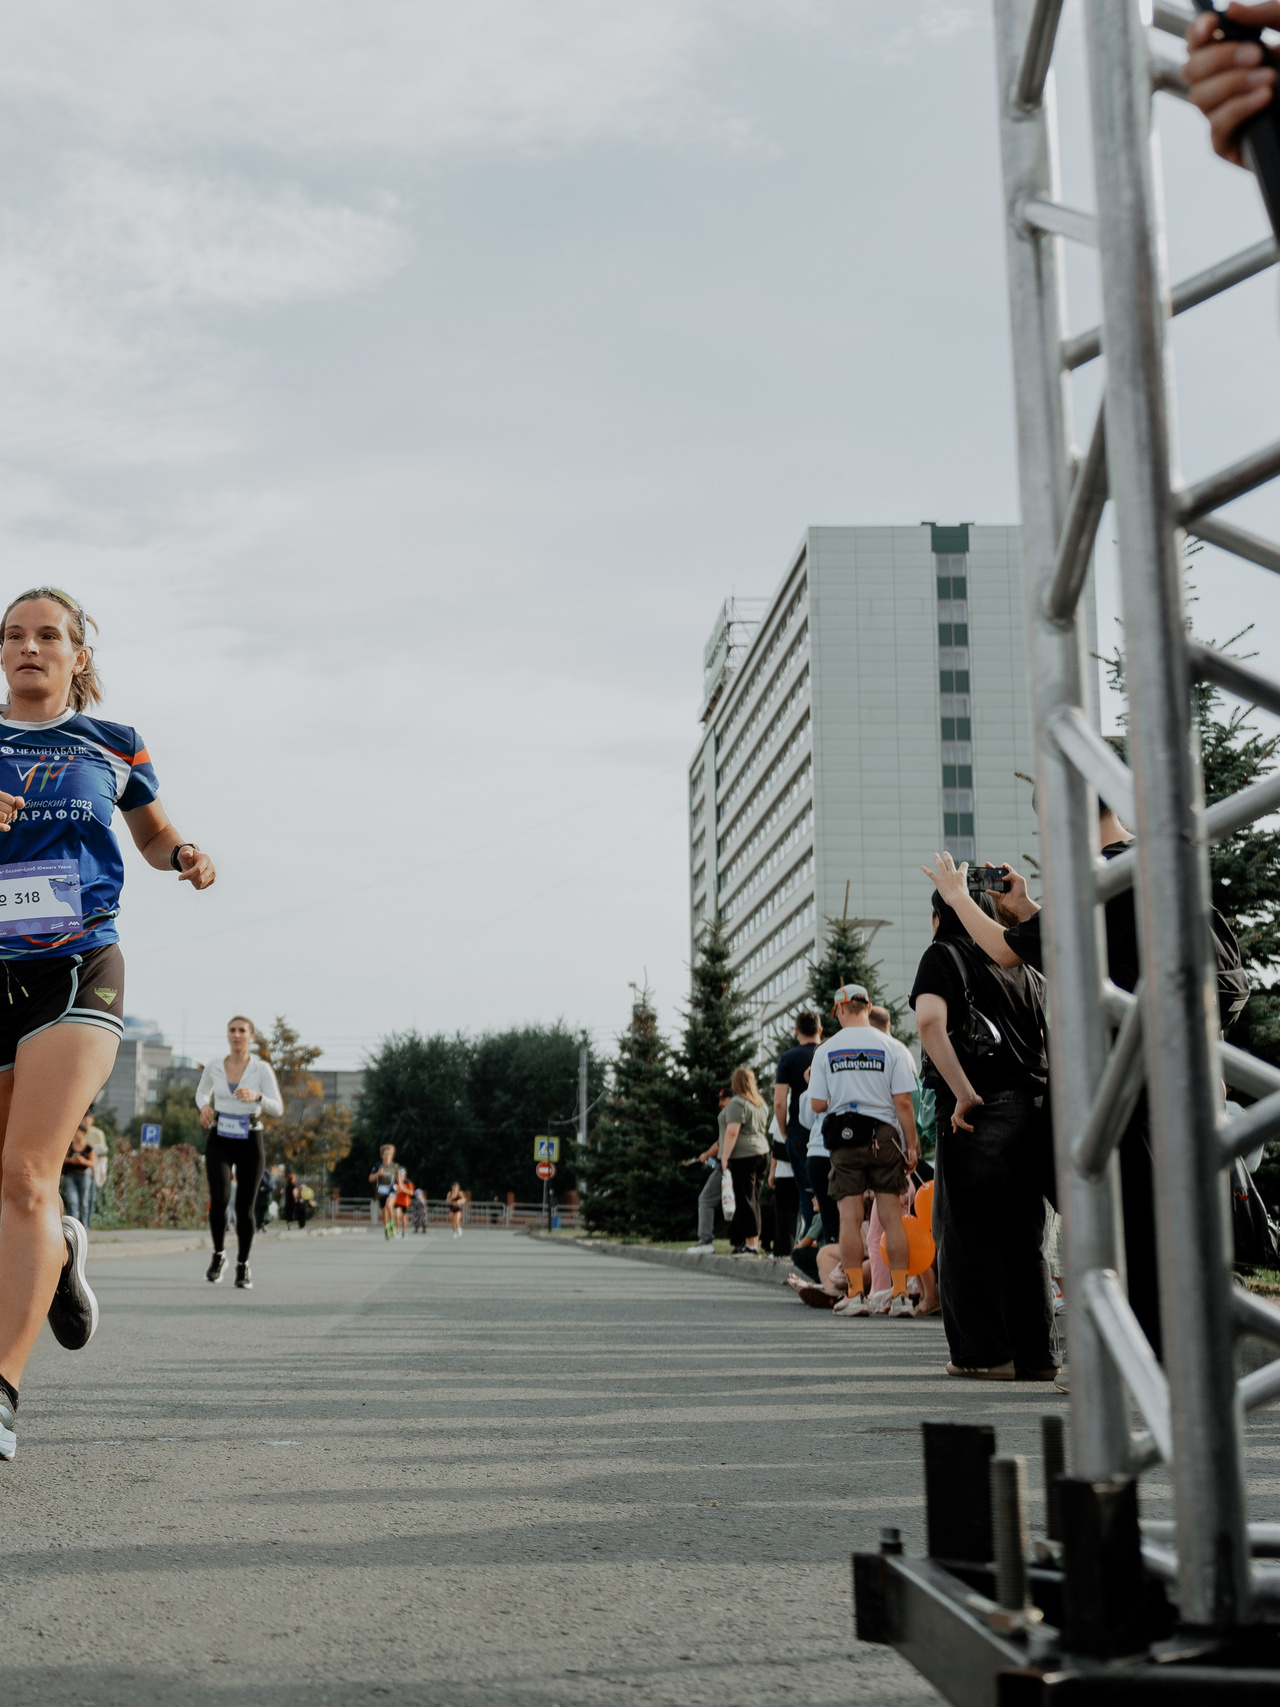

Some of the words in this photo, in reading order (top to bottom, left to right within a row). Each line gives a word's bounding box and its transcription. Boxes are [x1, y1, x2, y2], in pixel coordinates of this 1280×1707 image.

[24, 798, 67, 809] бинский
[70, 799, 93, 809] 2023
[14, 891, 41, 905] 318
[832, 1060, 882, 1072] patagonia
[146, 1126, 157, 1141] P
